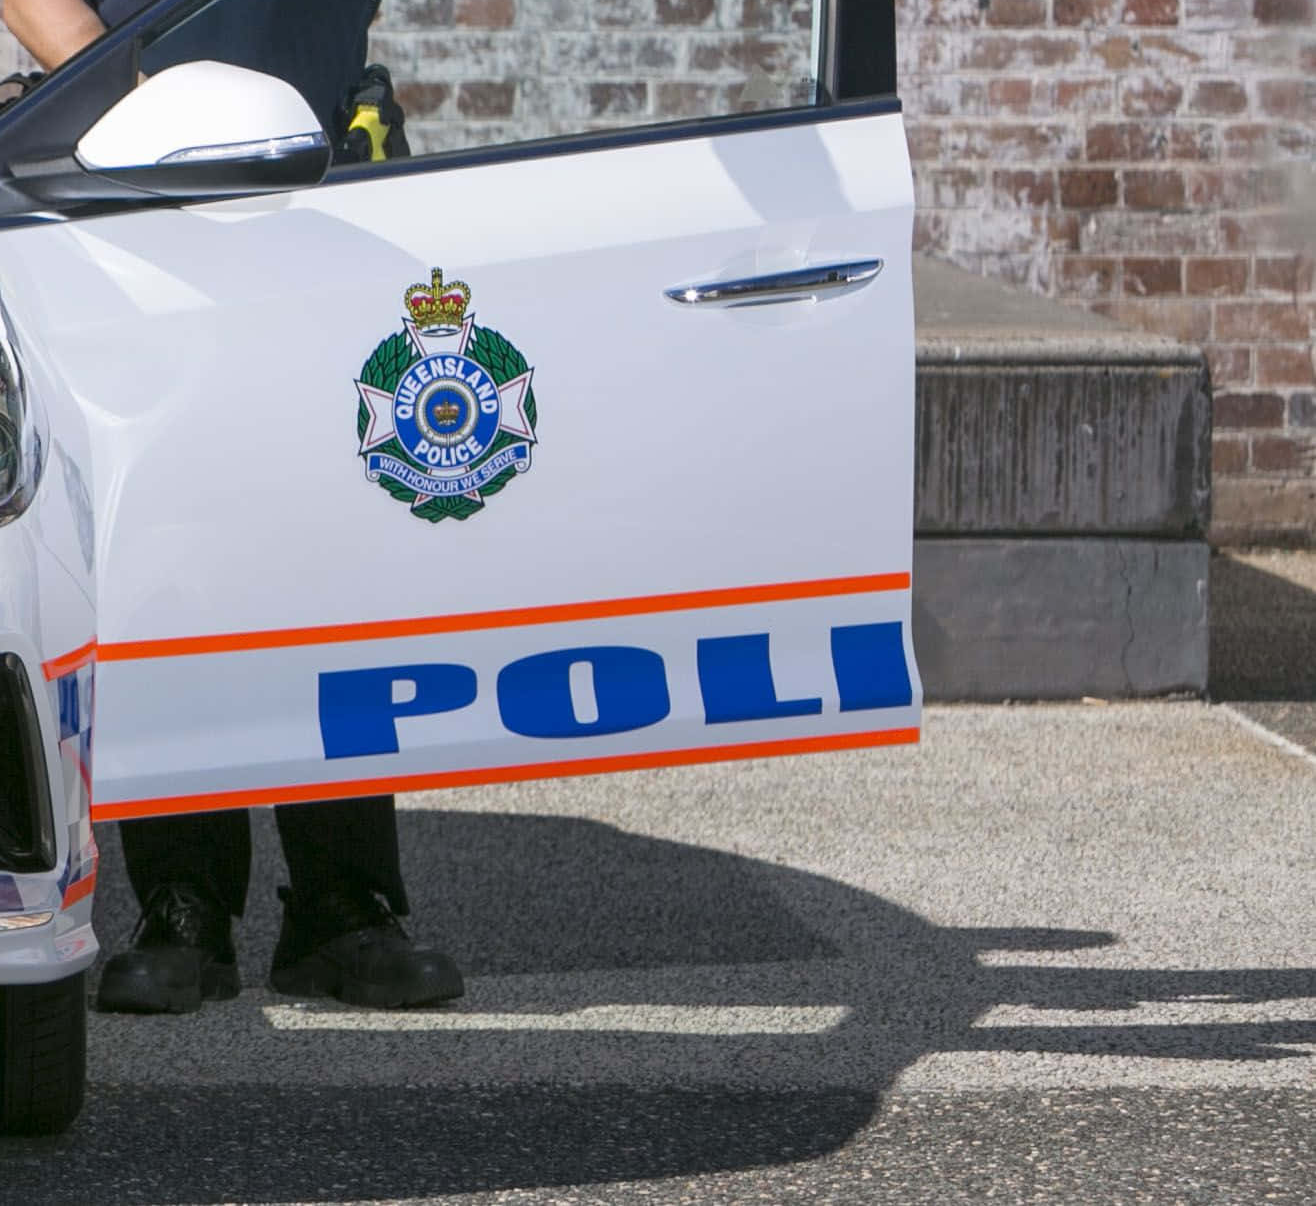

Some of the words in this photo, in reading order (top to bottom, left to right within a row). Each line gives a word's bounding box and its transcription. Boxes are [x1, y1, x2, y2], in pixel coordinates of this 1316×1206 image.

[396, 357, 498, 420] QUEENSLAND
[379, 457, 407, 479] WITH
[407, 474, 459, 492] HONOUR
[460, 473, 482, 490] WE
[481, 449, 517, 478] SERVE
[413, 435, 484, 466] POLICE
[318, 620, 913, 761] POLI
